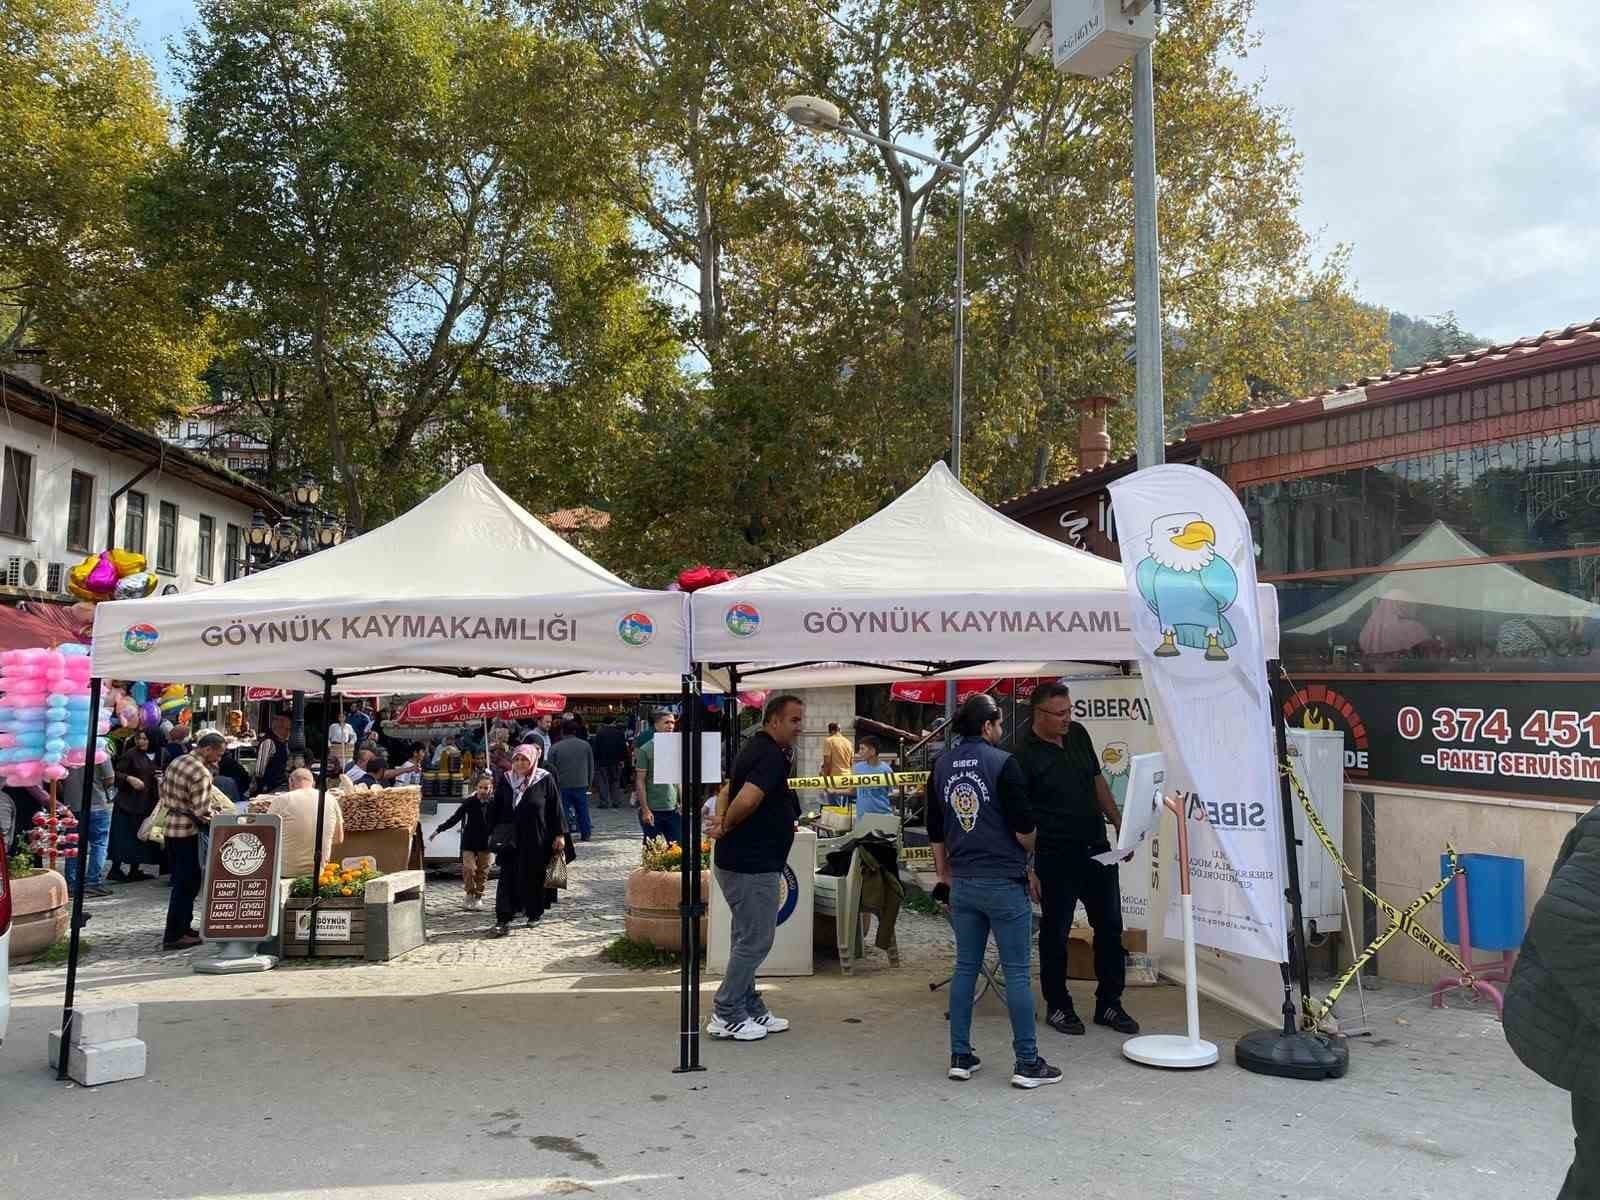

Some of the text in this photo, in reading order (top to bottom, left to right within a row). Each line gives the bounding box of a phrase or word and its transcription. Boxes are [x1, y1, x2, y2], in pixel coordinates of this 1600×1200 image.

[201, 613, 577, 647] GÖYNÜK KAYMAKAMLIĞI
[803, 607, 1131, 634] GÖYNÜK KAYMAKAML
[1398, 706, 1600, 748] 0 374 451
[1344, 751, 1368, 769] DE
